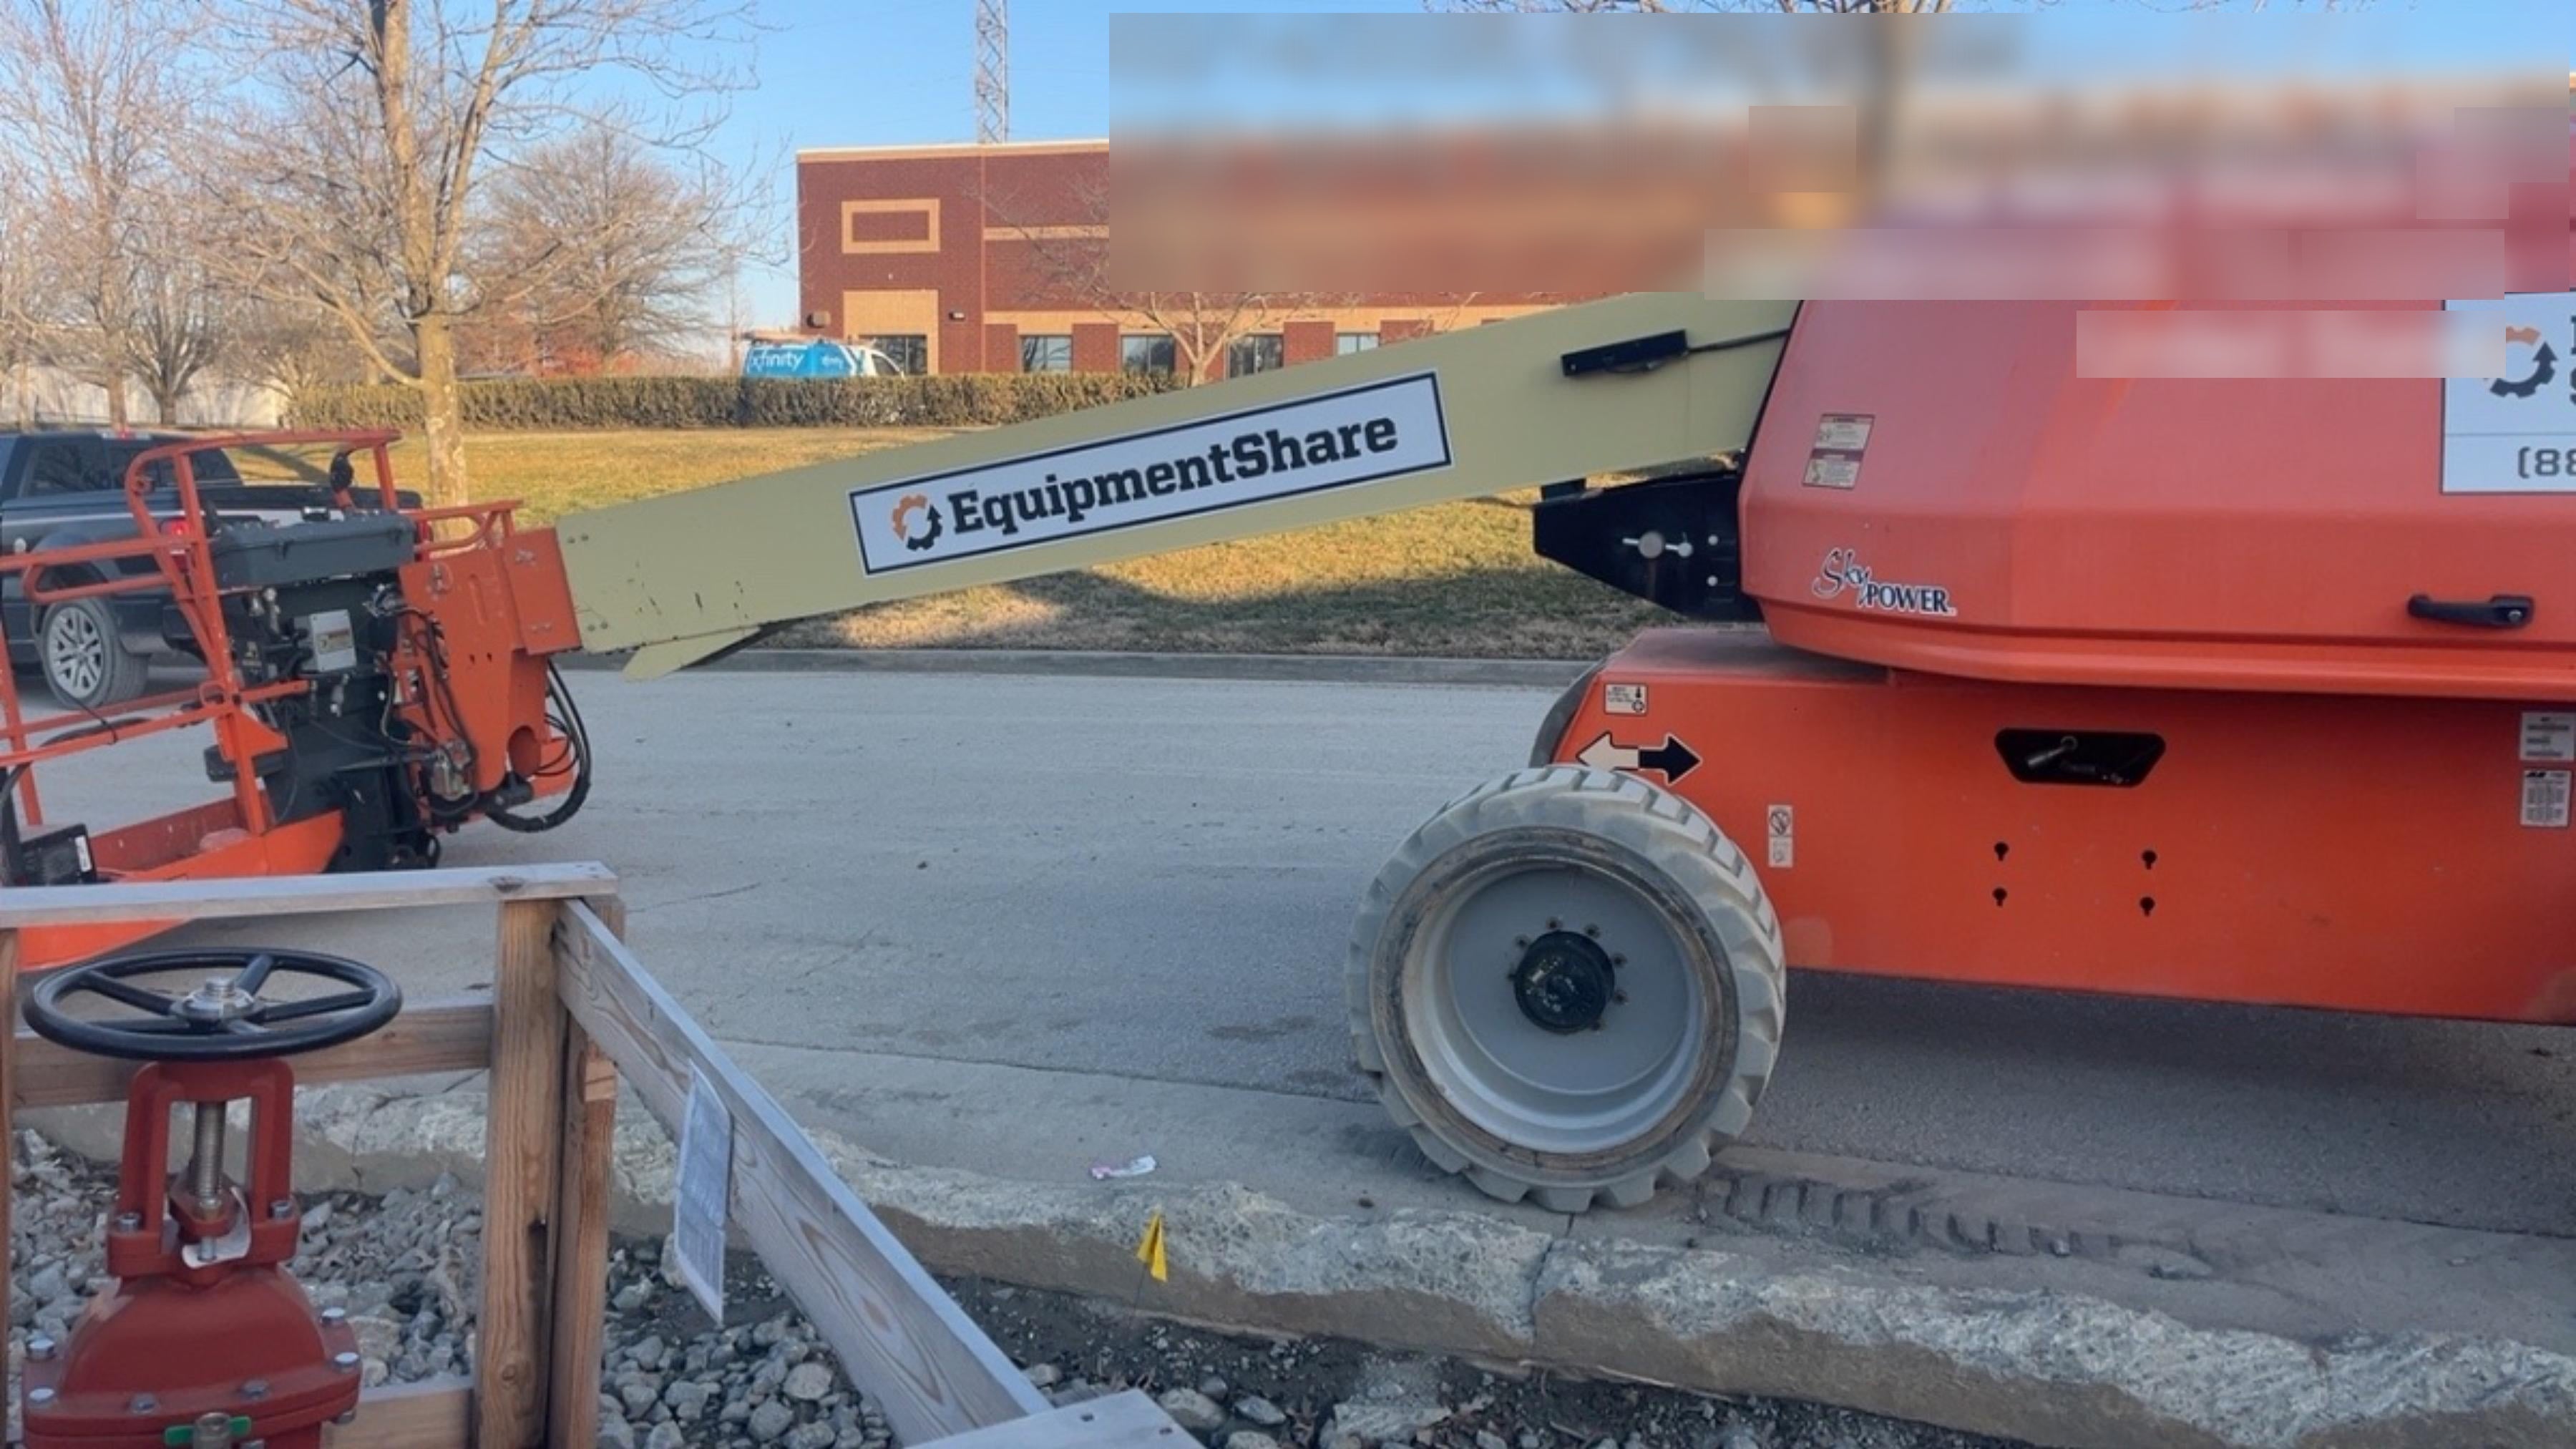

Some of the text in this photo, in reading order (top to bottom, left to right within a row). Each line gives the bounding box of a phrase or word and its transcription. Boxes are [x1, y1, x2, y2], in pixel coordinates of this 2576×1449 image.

[948, 417, 1397, 534] EquipmentShare
[1812, 547, 1872, 607] Sky
[1865, 582, 1956, 616] POWER
